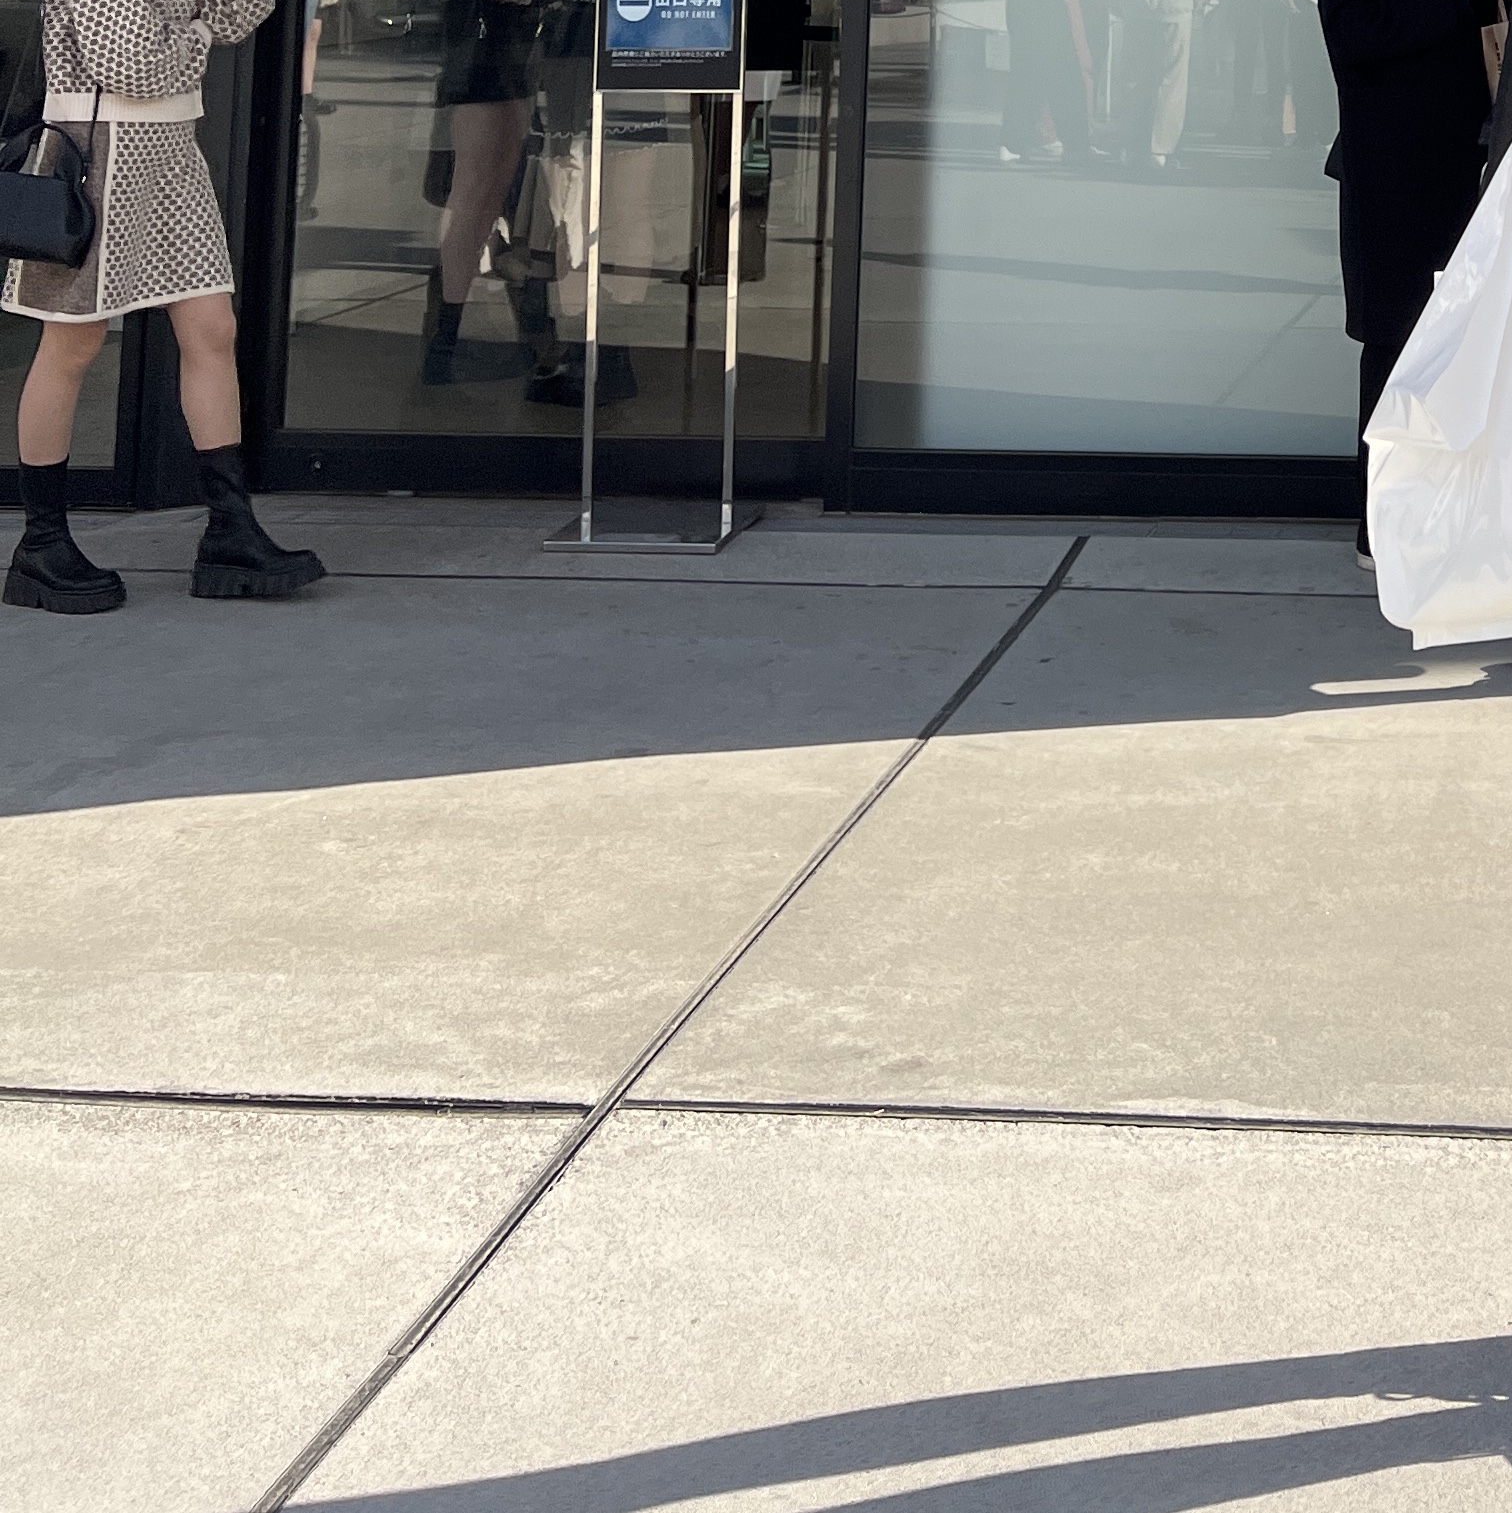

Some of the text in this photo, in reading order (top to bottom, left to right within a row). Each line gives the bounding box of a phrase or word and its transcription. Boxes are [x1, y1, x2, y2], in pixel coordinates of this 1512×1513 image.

[661, 10, 716, 19] DO NOT ENTER
